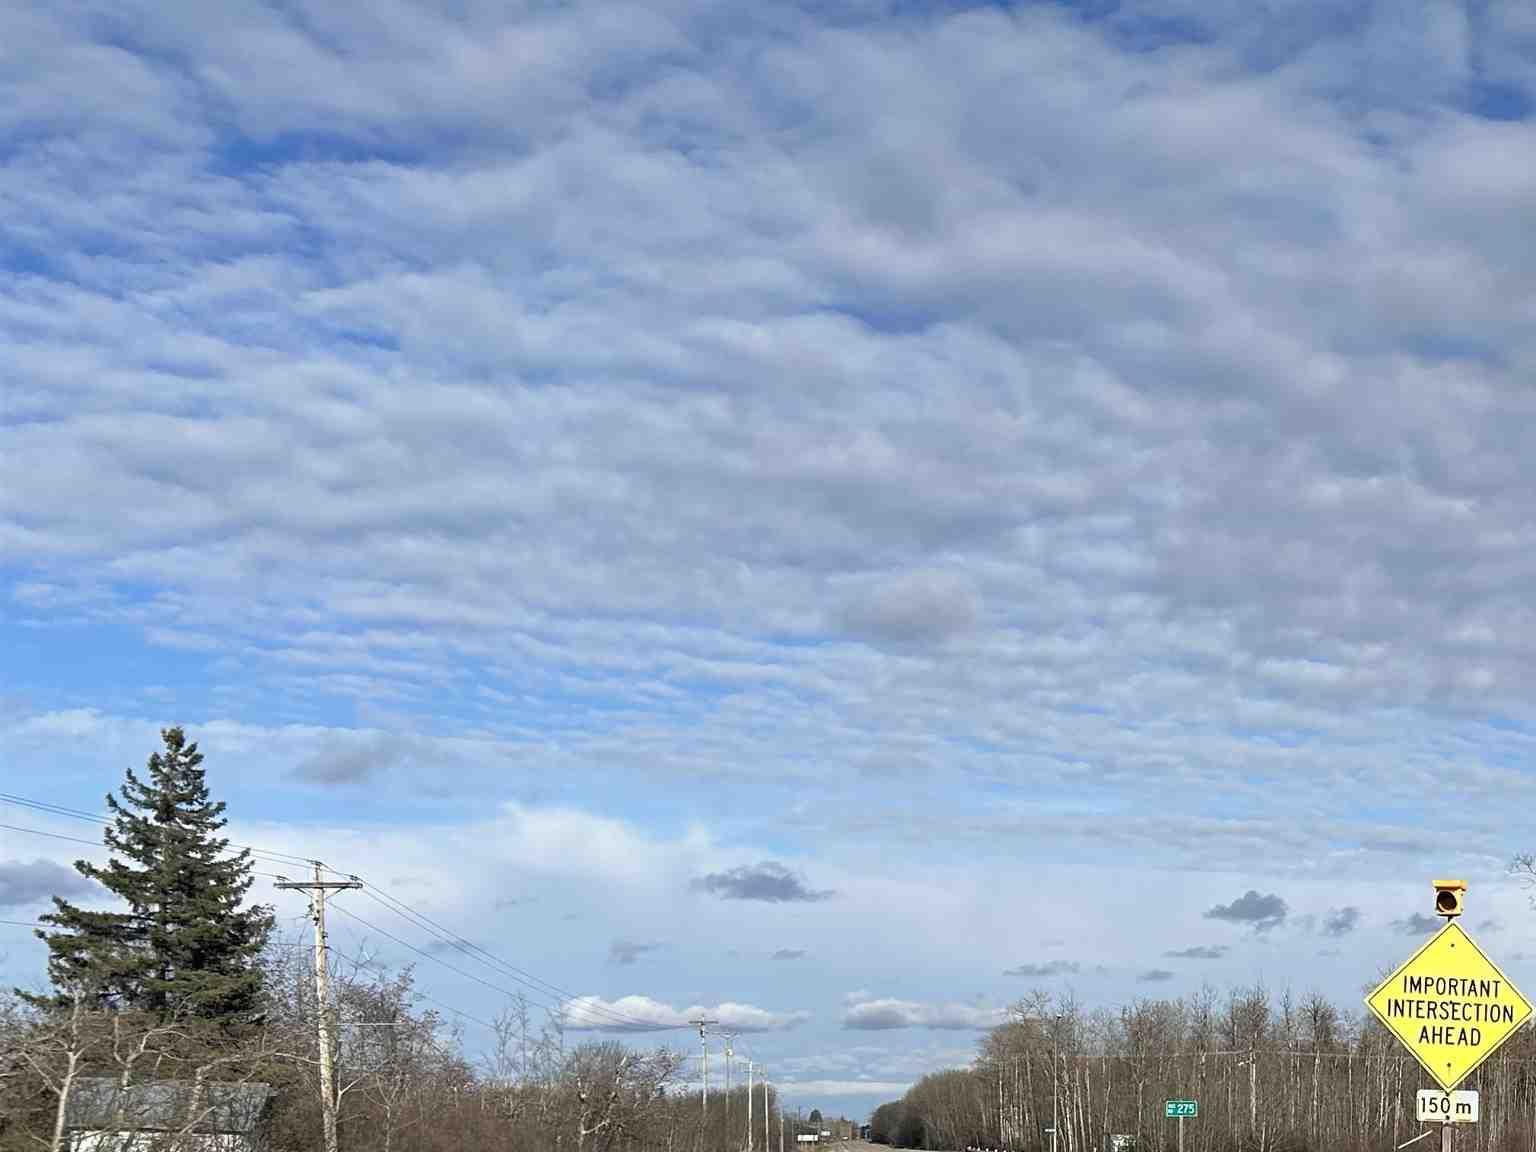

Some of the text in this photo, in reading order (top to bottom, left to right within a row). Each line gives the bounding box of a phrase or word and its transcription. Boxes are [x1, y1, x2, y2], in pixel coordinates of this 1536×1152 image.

[1403, 976, 1502, 998] IMPORTANT
[1387, 999, 1514, 1023] INTERSECTION
[1418, 1027, 1481, 1046] AHEAD
[1177, 1103, 1195, 1114] 275
[1421, 1097, 1472, 1115] 150 m
